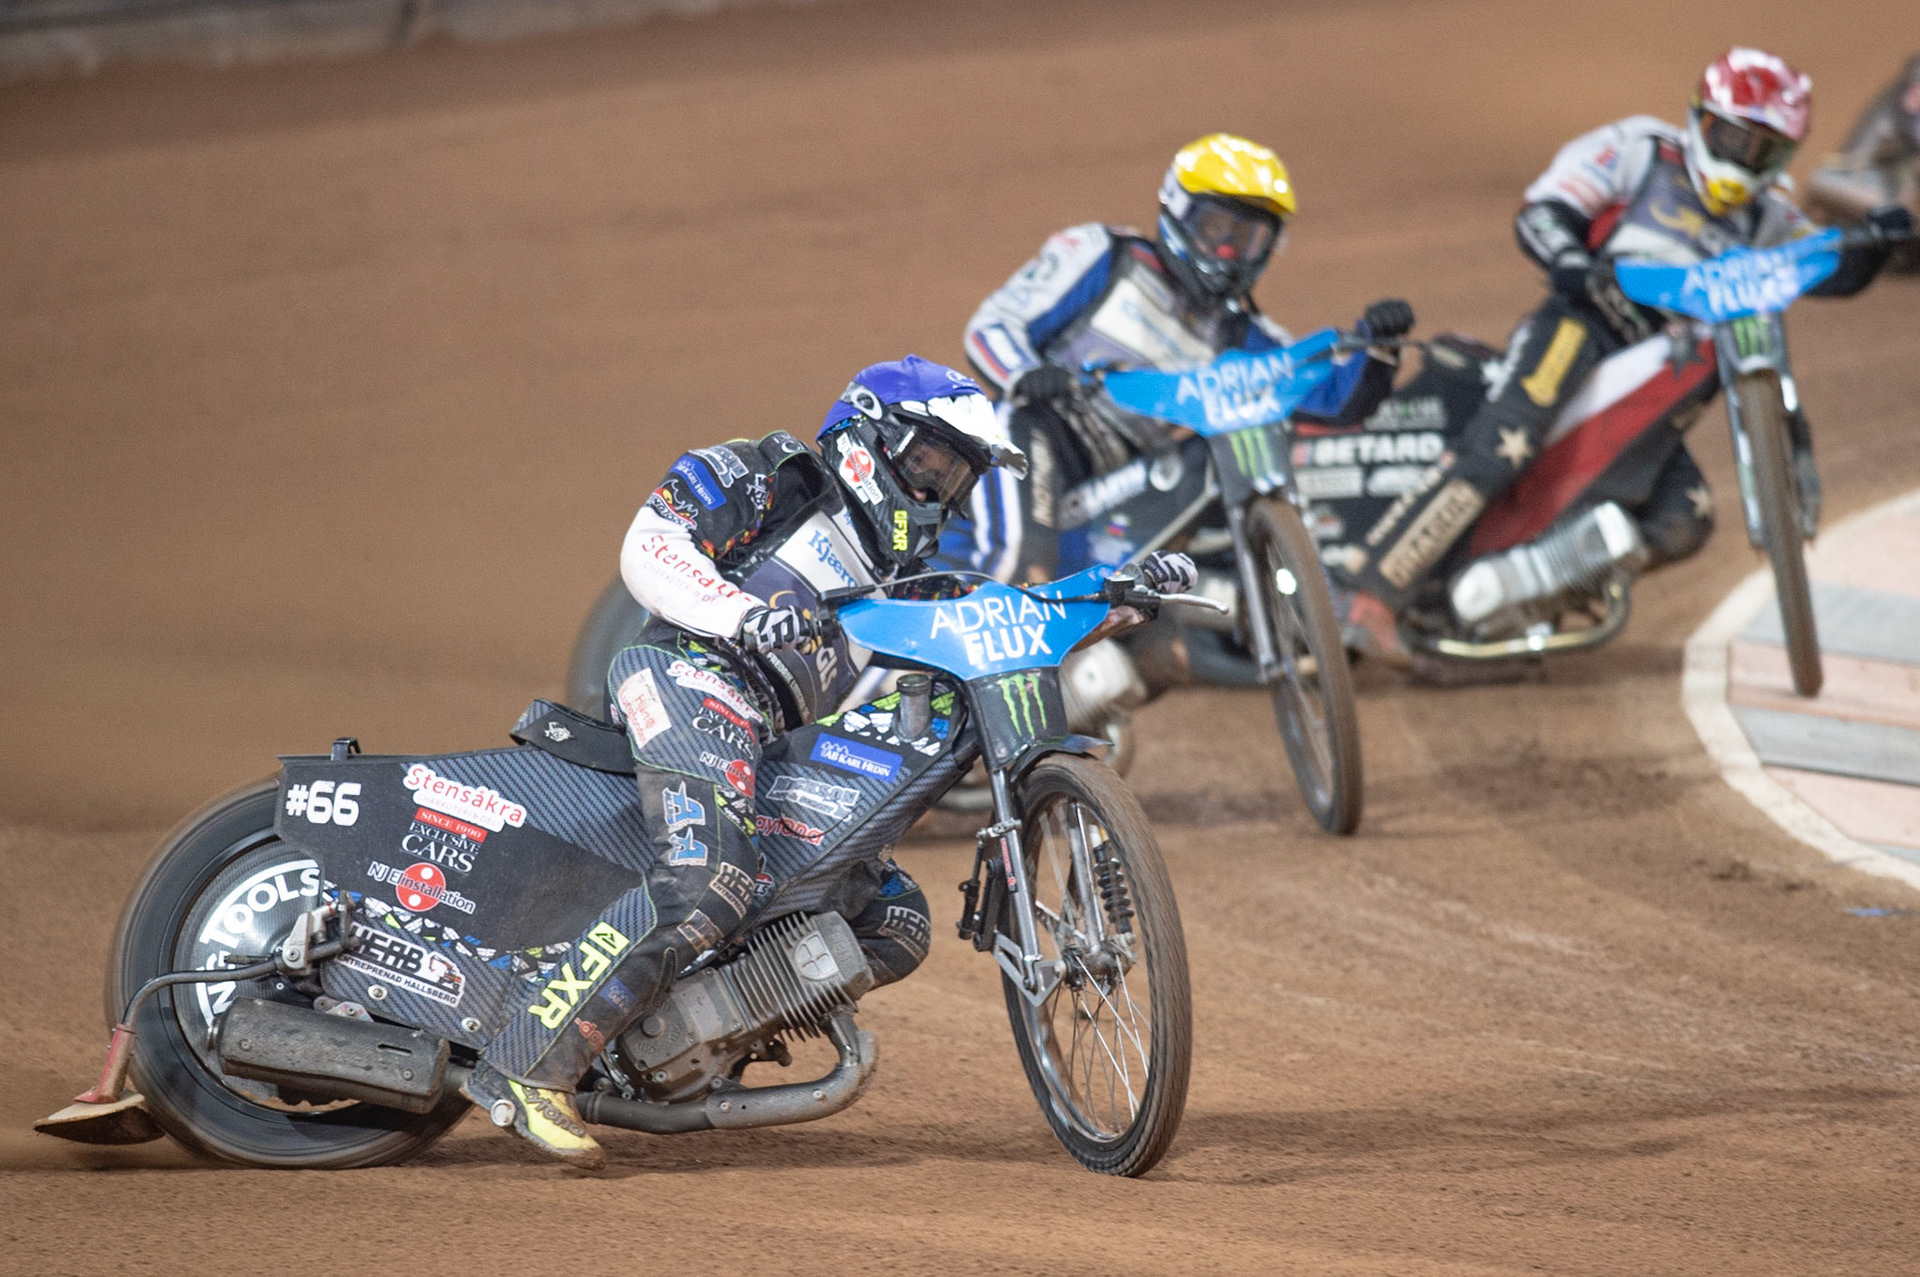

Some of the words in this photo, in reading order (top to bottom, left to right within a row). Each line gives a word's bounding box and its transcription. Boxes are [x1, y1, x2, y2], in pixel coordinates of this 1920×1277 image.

[1176, 350, 1295, 405] ADRIAN
[893, 522, 908, 551] FXR
[931, 589, 1067, 639] ADRIAN
[963, 623, 1053, 666] FLUX
[838, 753, 860, 768] KARL
[861, 760, 891, 777] HEDIN
[286, 780, 362, 827] #66
[408, 767, 523, 824] Stensåkra
[409, 821, 480, 855] EXCLUSIVE
[421, 811, 453, 829] SINCE
[456, 823, 482, 839] 1990
[756, 814, 824, 846] aytona
[368, 860, 388, 883] NJ
[402, 833, 476, 873] CARS
[199, 867, 321, 949] TOOLS
[404, 977, 458, 1004] HALLSBERG
[527, 941, 611, 1030] FXR
[522, 1085, 586, 1138] aytona
